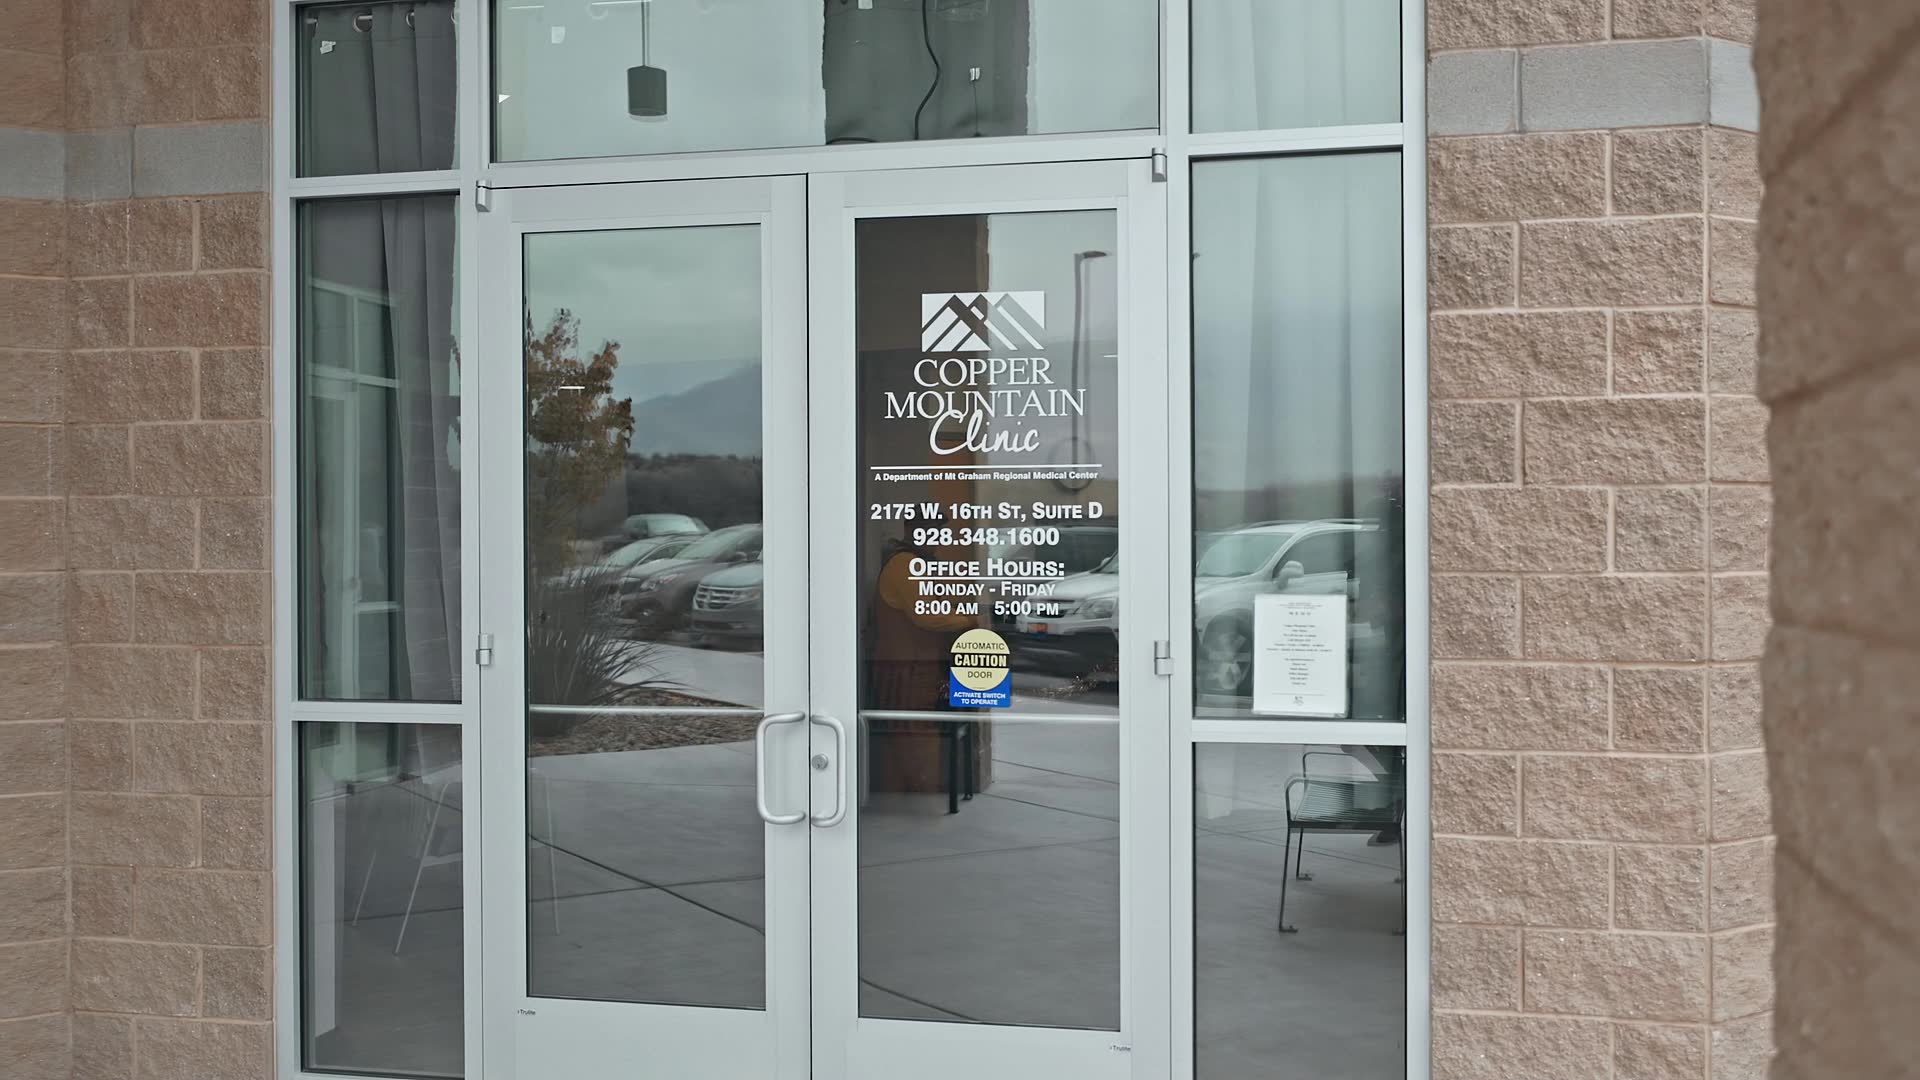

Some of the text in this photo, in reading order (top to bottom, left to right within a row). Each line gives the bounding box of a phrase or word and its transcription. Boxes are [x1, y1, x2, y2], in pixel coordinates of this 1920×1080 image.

[913, 357, 1055, 387] COPPER
[884, 388, 1087, 419] MOUNTAIN
[929, 408, 1040, 455] Clinic
[874, 471, 1098, 483] A Department of Mt Graham Regional Medical Center
[870, 503, 916, 520] 2175
[920, 503, 943, 519] W.
[949, 502, 992, 519] 16TH
[1032, 501, 1082, 519] SUITE
[1088, 501, 1103, 519] D
[912, 527, 1060, 546] 928.348.1600
[908, 557, 1065, 577] OFFICE HOURS:
[918, 581, 985, 596] MONDAY
[1001, 581, 1056, 596] FRIDAY
[914, 600, 1059, 616] 8:00 AM 5:00 PM
[955, 642, 1005, 650] AUTOMATIC
[954, 653, 1007, 667] CAUTION
[967, 671, 993, 679] DOOR
[953, 691, 982, 699] ACTIVATE
[970, 698, 998, 706] OPERATE
